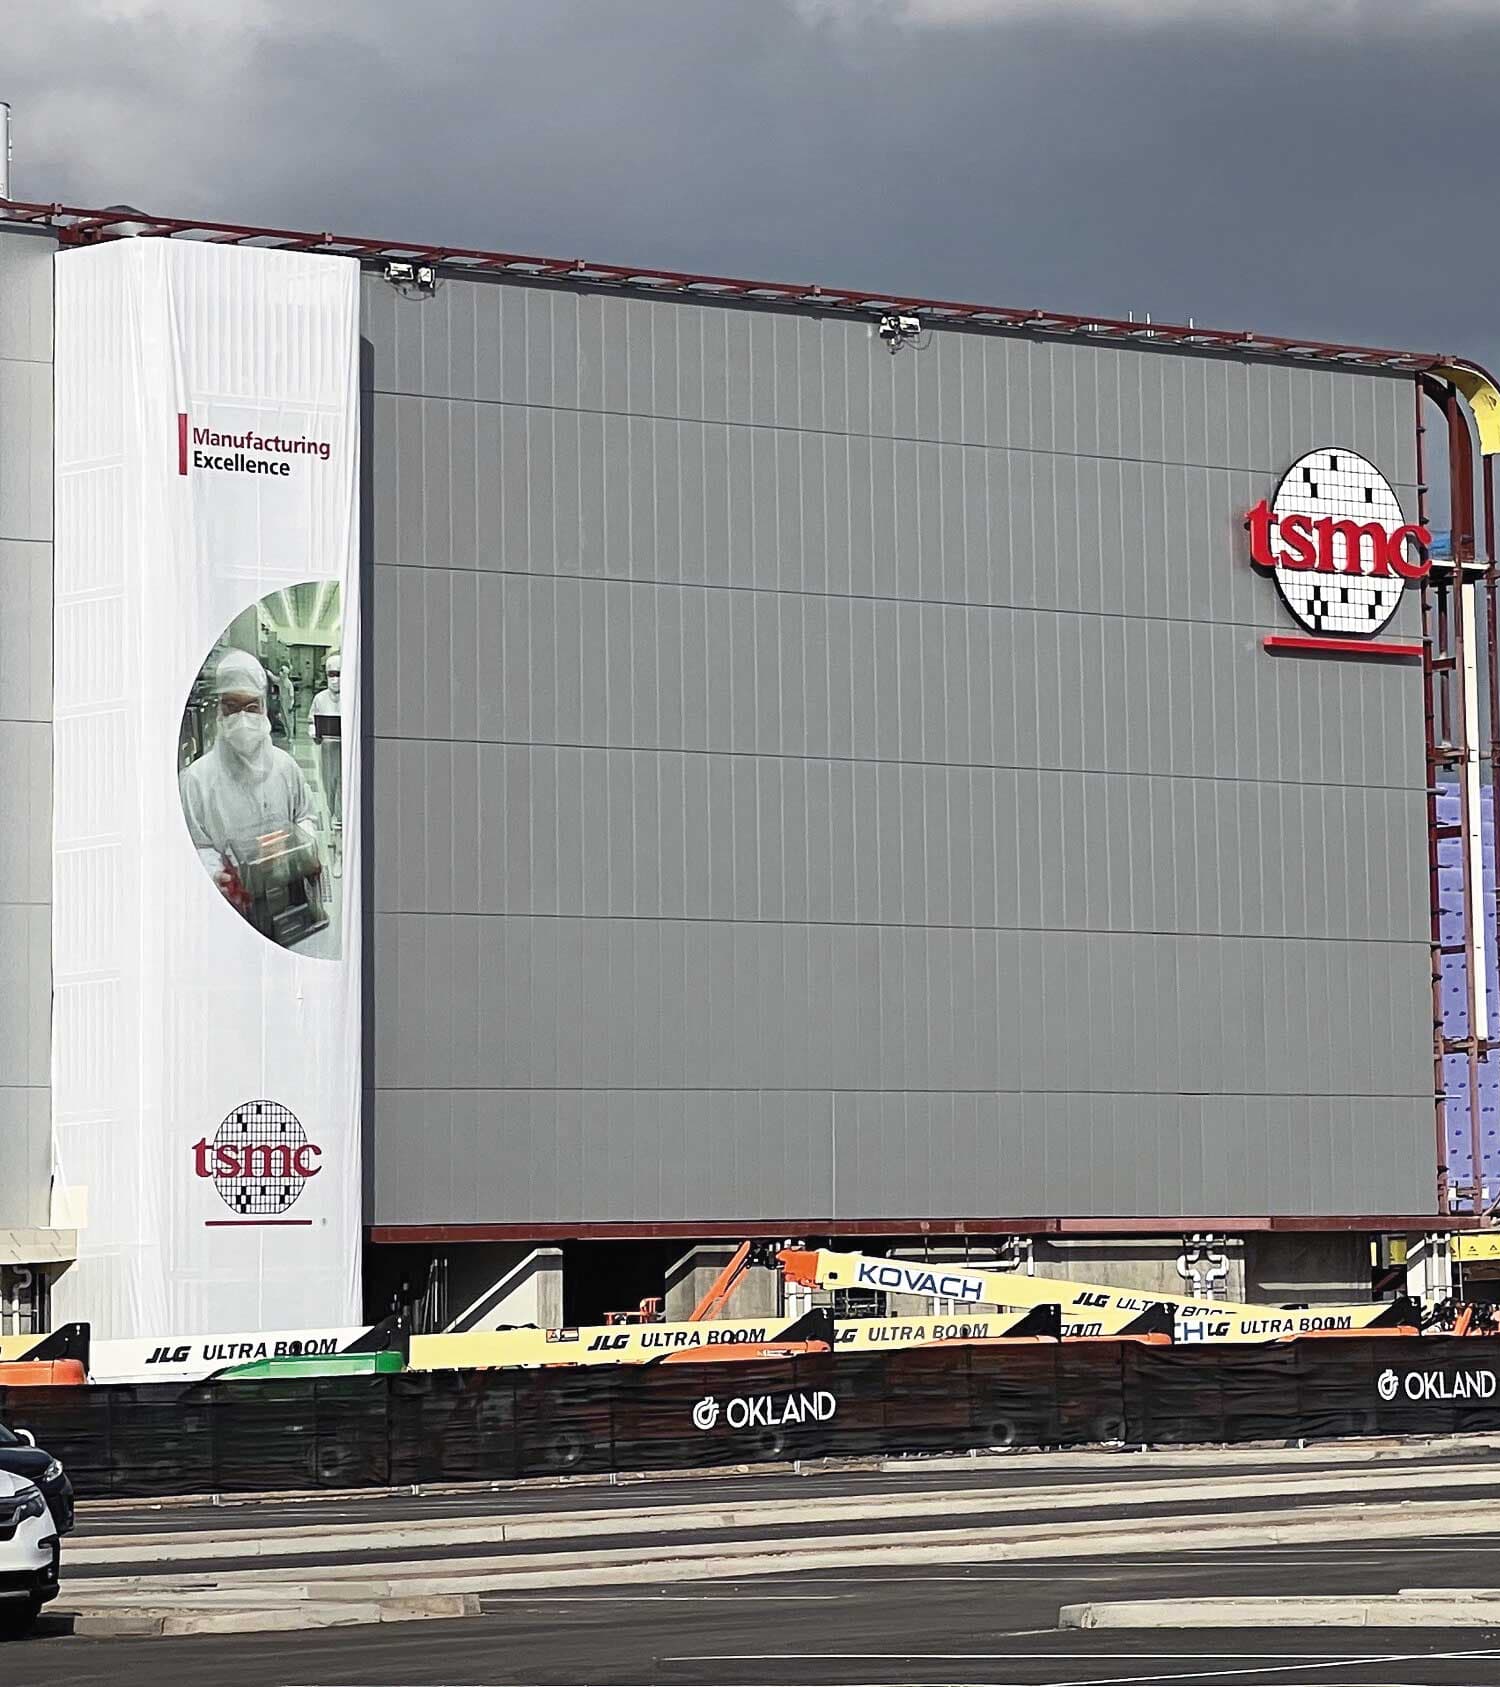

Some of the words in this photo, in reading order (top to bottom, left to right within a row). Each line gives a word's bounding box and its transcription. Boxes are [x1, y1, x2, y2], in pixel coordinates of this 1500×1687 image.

[193, 427, 331, 460] Manufacturing
[193, 451, 291, 476] Excellence
[1244, 498, 1433, 580] tsmc
[192, 1137, 322, 1178] tsmc
[859, 1263, 983, 1300] KOVACH
[1072, 1292, 1111, 1308] JLG
[587, 1334, 631, 1351] JLG
[640, 1331, 701, 1347] ULTRA
[707, 1328, 766, 1344] BOOM
[834, 1328, 858, 1343] LG
[868, 1326, 925, 1341] ULTRA
[933, 1323, 989, 1339] BOOM
[1207, 1322, 1231, 1336] LG
[1240, 1319, 1294, 1334] ULTRA
[1300, 1316, 1352, 1331] BOOM
[145, 1345, 192, 1364] JLG
[202, 1342, 268, 1360] ULTRA
[274, 1338, 338, 1356] BOOM
[1404, 1370, 1497, 1400] OKLAND
[727, 1391, 837, 1428] OKLAND
